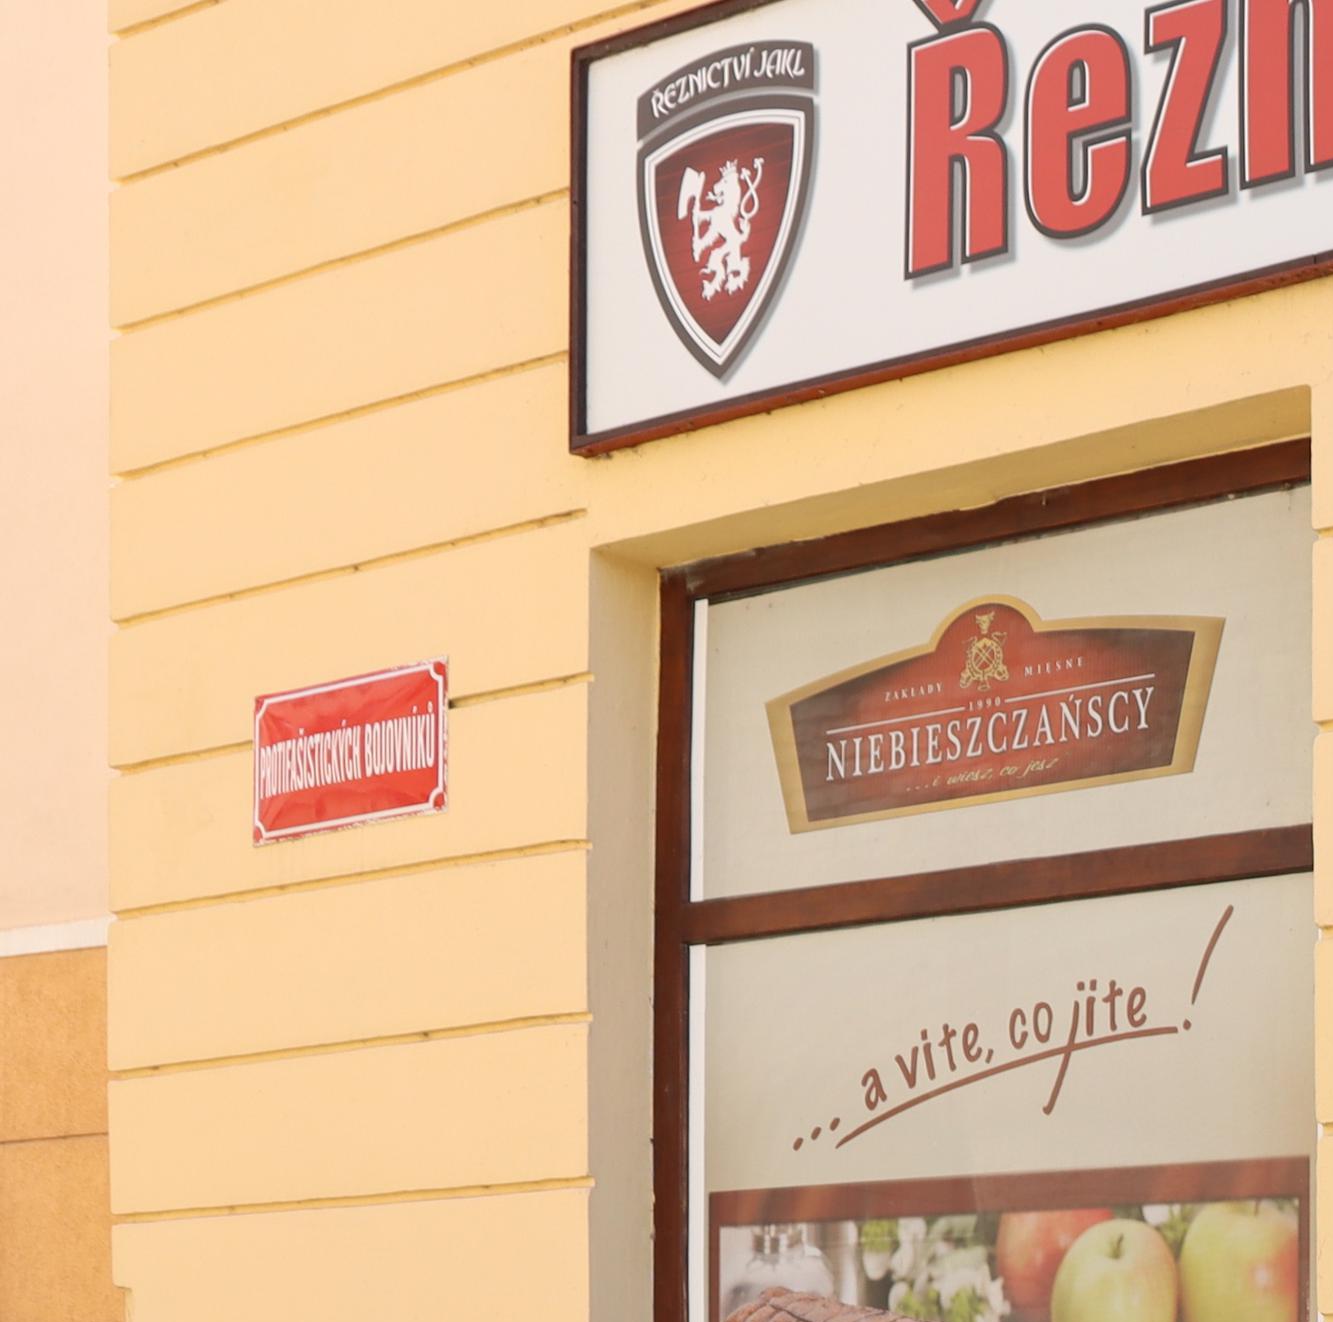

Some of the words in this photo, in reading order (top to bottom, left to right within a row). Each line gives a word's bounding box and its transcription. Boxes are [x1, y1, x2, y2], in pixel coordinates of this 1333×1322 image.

[651, 47, 755, 118] ŘEZNICTVÍ
[753, 48, 805, 78] JAKL
[826, 687, 1155, 781] NIEBIESZCZAŃSCY
[968, 697, 1001, 711] 1990
[260, 719, 362, 800] PROTIFAŠISTICKÝCH
[364, 700, 435, 778] BOJOVNÍKŮ
[999, 764, 1018, 777] co
[1008, 1001, 1054, 1050] co
